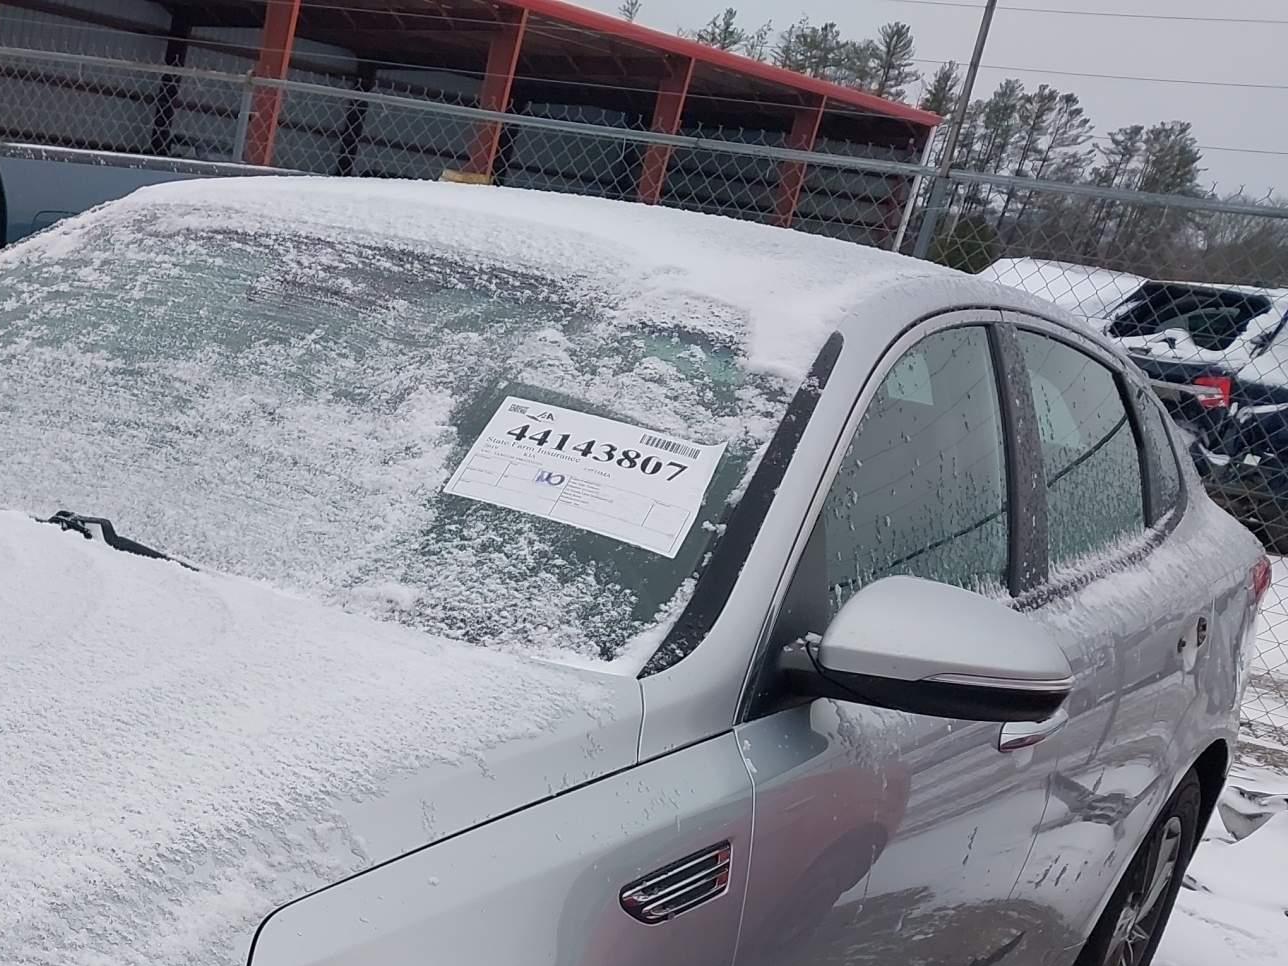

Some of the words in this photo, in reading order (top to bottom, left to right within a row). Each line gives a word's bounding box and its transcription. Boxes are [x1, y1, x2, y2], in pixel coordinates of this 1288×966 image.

[486, 436, 509, 446] State
[511, 441, 535, 452] Farm
[537, 447, 581, 463] Insurance
[506, 424, 689, 481] 44143807
